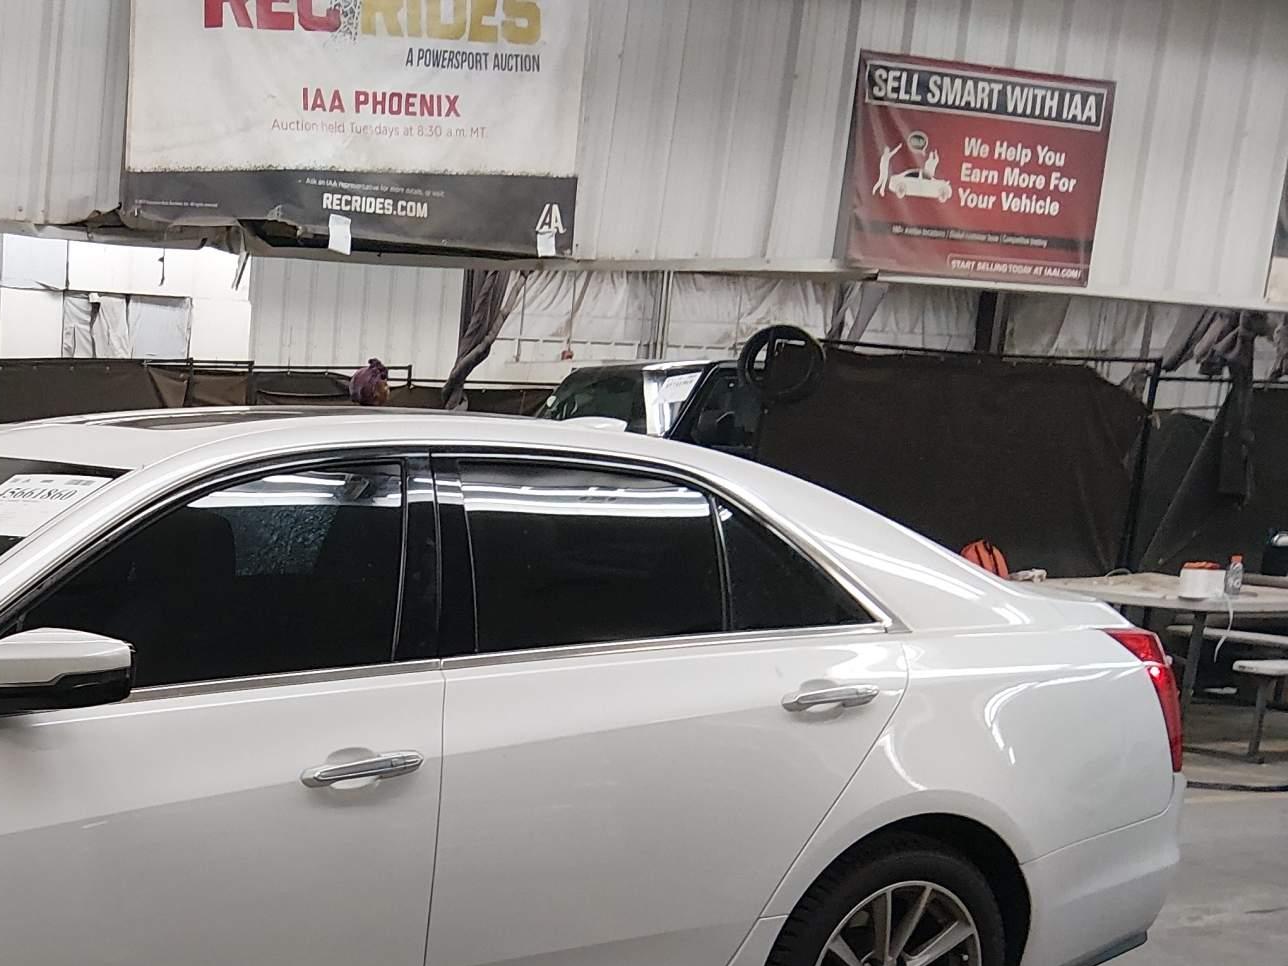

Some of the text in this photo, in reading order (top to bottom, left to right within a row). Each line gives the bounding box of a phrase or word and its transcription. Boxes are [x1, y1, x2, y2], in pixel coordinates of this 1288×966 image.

[405, 47, 541, 72] A POWERSPORT AUCTION
[302, 87, 461, 117] IAA PHOENIX
[872, 68, 1097, 123] SELL SMART WITH IAA
[271, 118, 319, 132] Auction
[321, 122, 345, 133] held
[403, 126, 413, 137] at
[417, 125, 442, 137] 8:30
[964, 136, 1066, 167] We Help You
[960, 162, 1077, 193] Earn More For
[322, 192, 428, 219] RECRIDES.COM
[958, 187, 1060, 216] Your Vehicle
[951, 259, 975, 271] START
